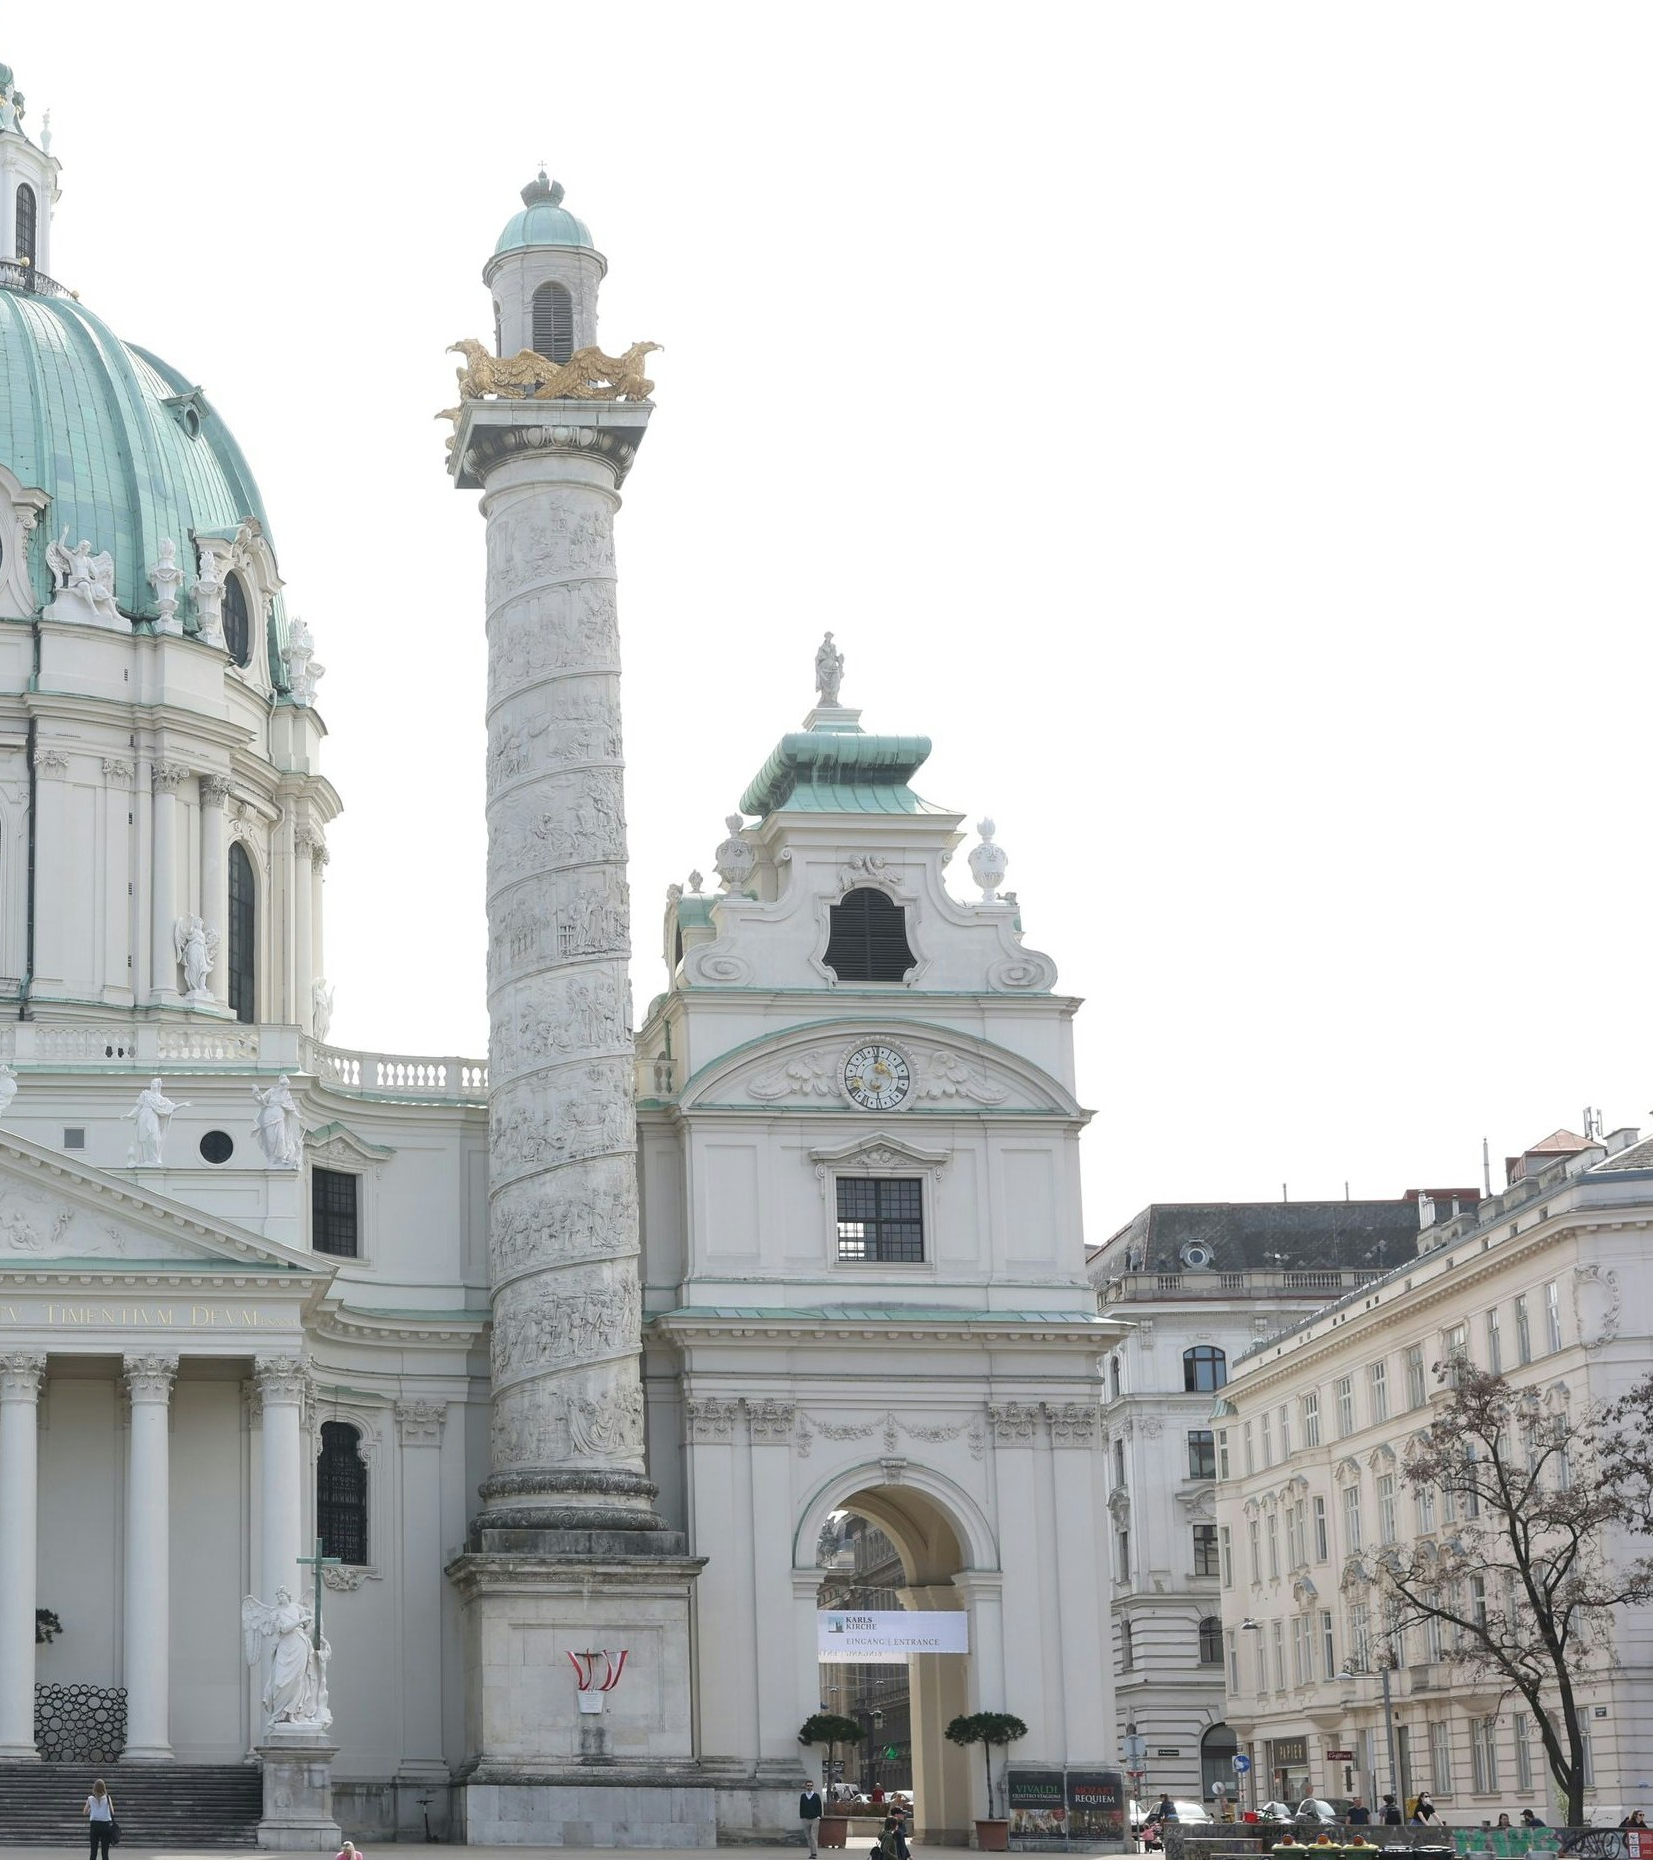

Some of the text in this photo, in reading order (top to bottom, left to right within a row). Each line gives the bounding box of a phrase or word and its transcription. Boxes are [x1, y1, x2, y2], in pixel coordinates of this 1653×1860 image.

[845, 1616, 873, 1624] KARLS
[845, 1623, 878, 1631] KIRCHE
[894, 1638, 940, 1646] ENTRANCE
[1016, 1785, 1058, 1793] VIVALDI
[1075, 1786, 1115, 1796] MOZART
[1075, 1795, 1115, 1804] REQUIEM
